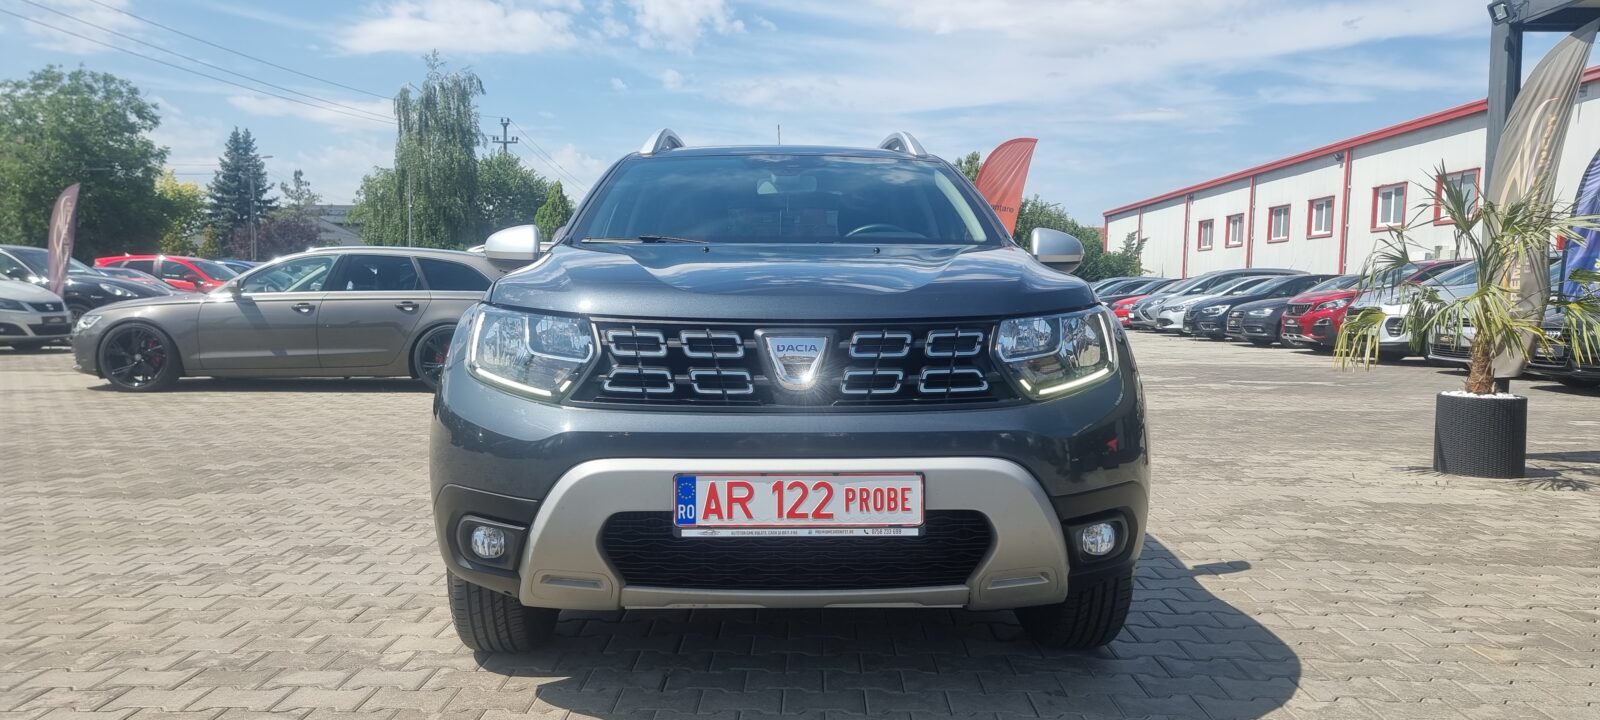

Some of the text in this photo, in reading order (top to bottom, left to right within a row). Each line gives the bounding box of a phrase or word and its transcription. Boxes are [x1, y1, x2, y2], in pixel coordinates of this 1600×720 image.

[776, 344, 818, 353] DACIA
[702, 480, 913, 520] AR 122 PROBE
[677, 504, 695, 519] RO
